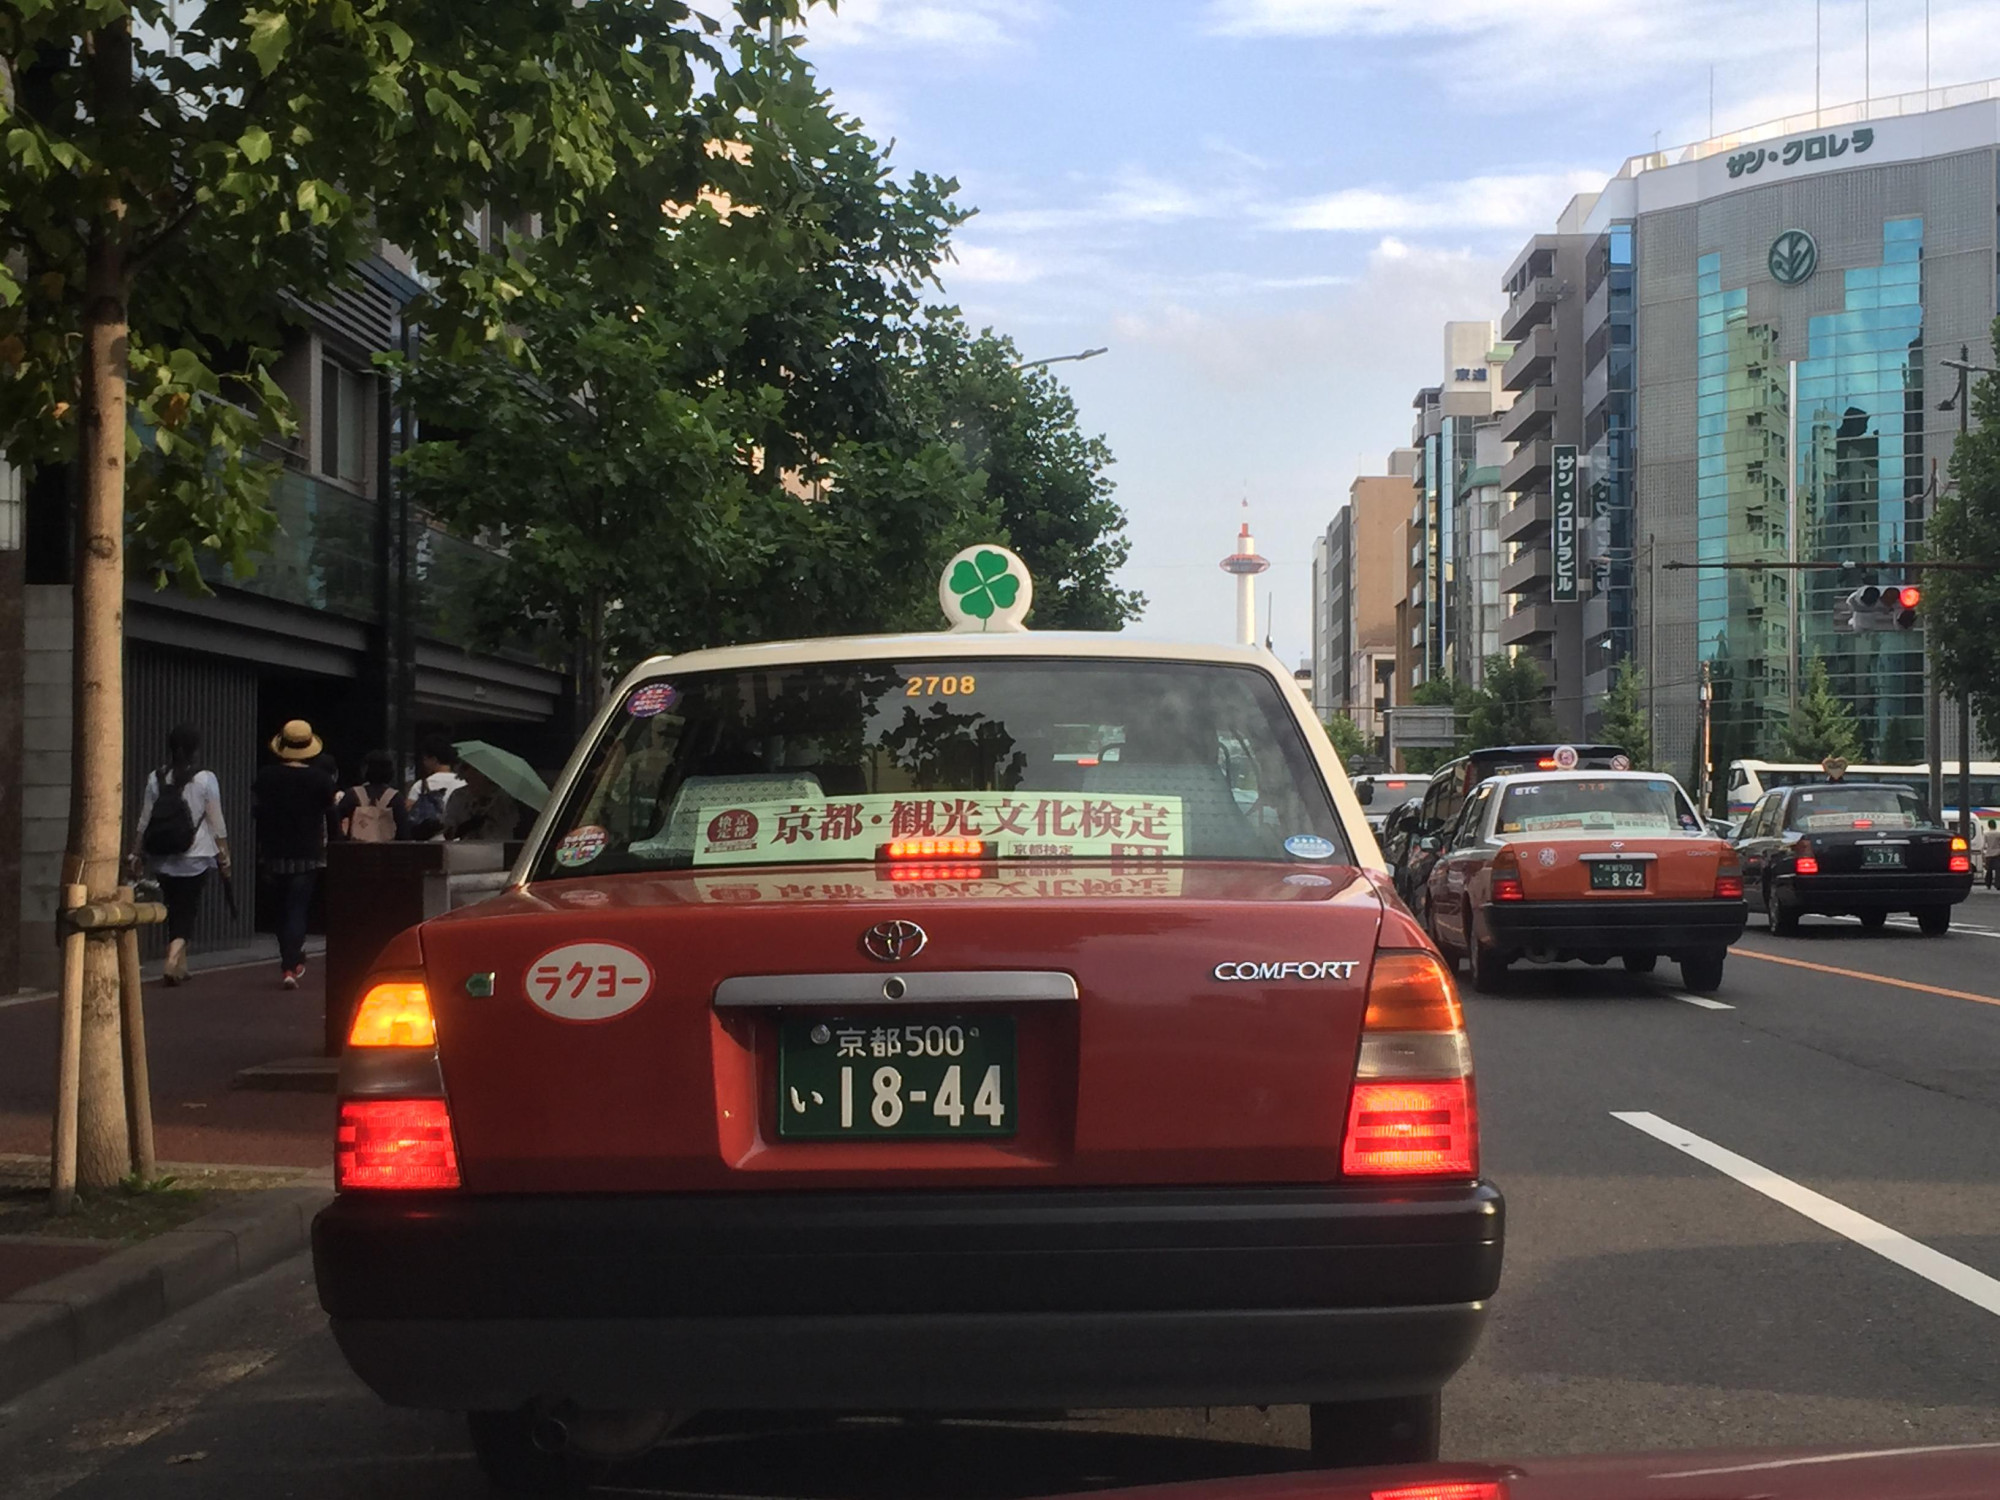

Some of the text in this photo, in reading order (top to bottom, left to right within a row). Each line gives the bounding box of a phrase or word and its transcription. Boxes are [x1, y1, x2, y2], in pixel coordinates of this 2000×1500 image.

[1726, 127, 1874, 179] サン・クロレラ
[1556, 455, 1575, 592] サン・クロレラビル
[906, 675, 976, 696] 2708
[1515, 786, 1540, 796] ETC
[770, 798, 1172, 845] 京都・観光文化検定
[1878, 852, 1900, 864] 378
[535, 961, 643, 1001] ラクヨー
[1214, 960, 1360, 981] COMFORT
[790, 1064, 1005, 1128] い 18-44
